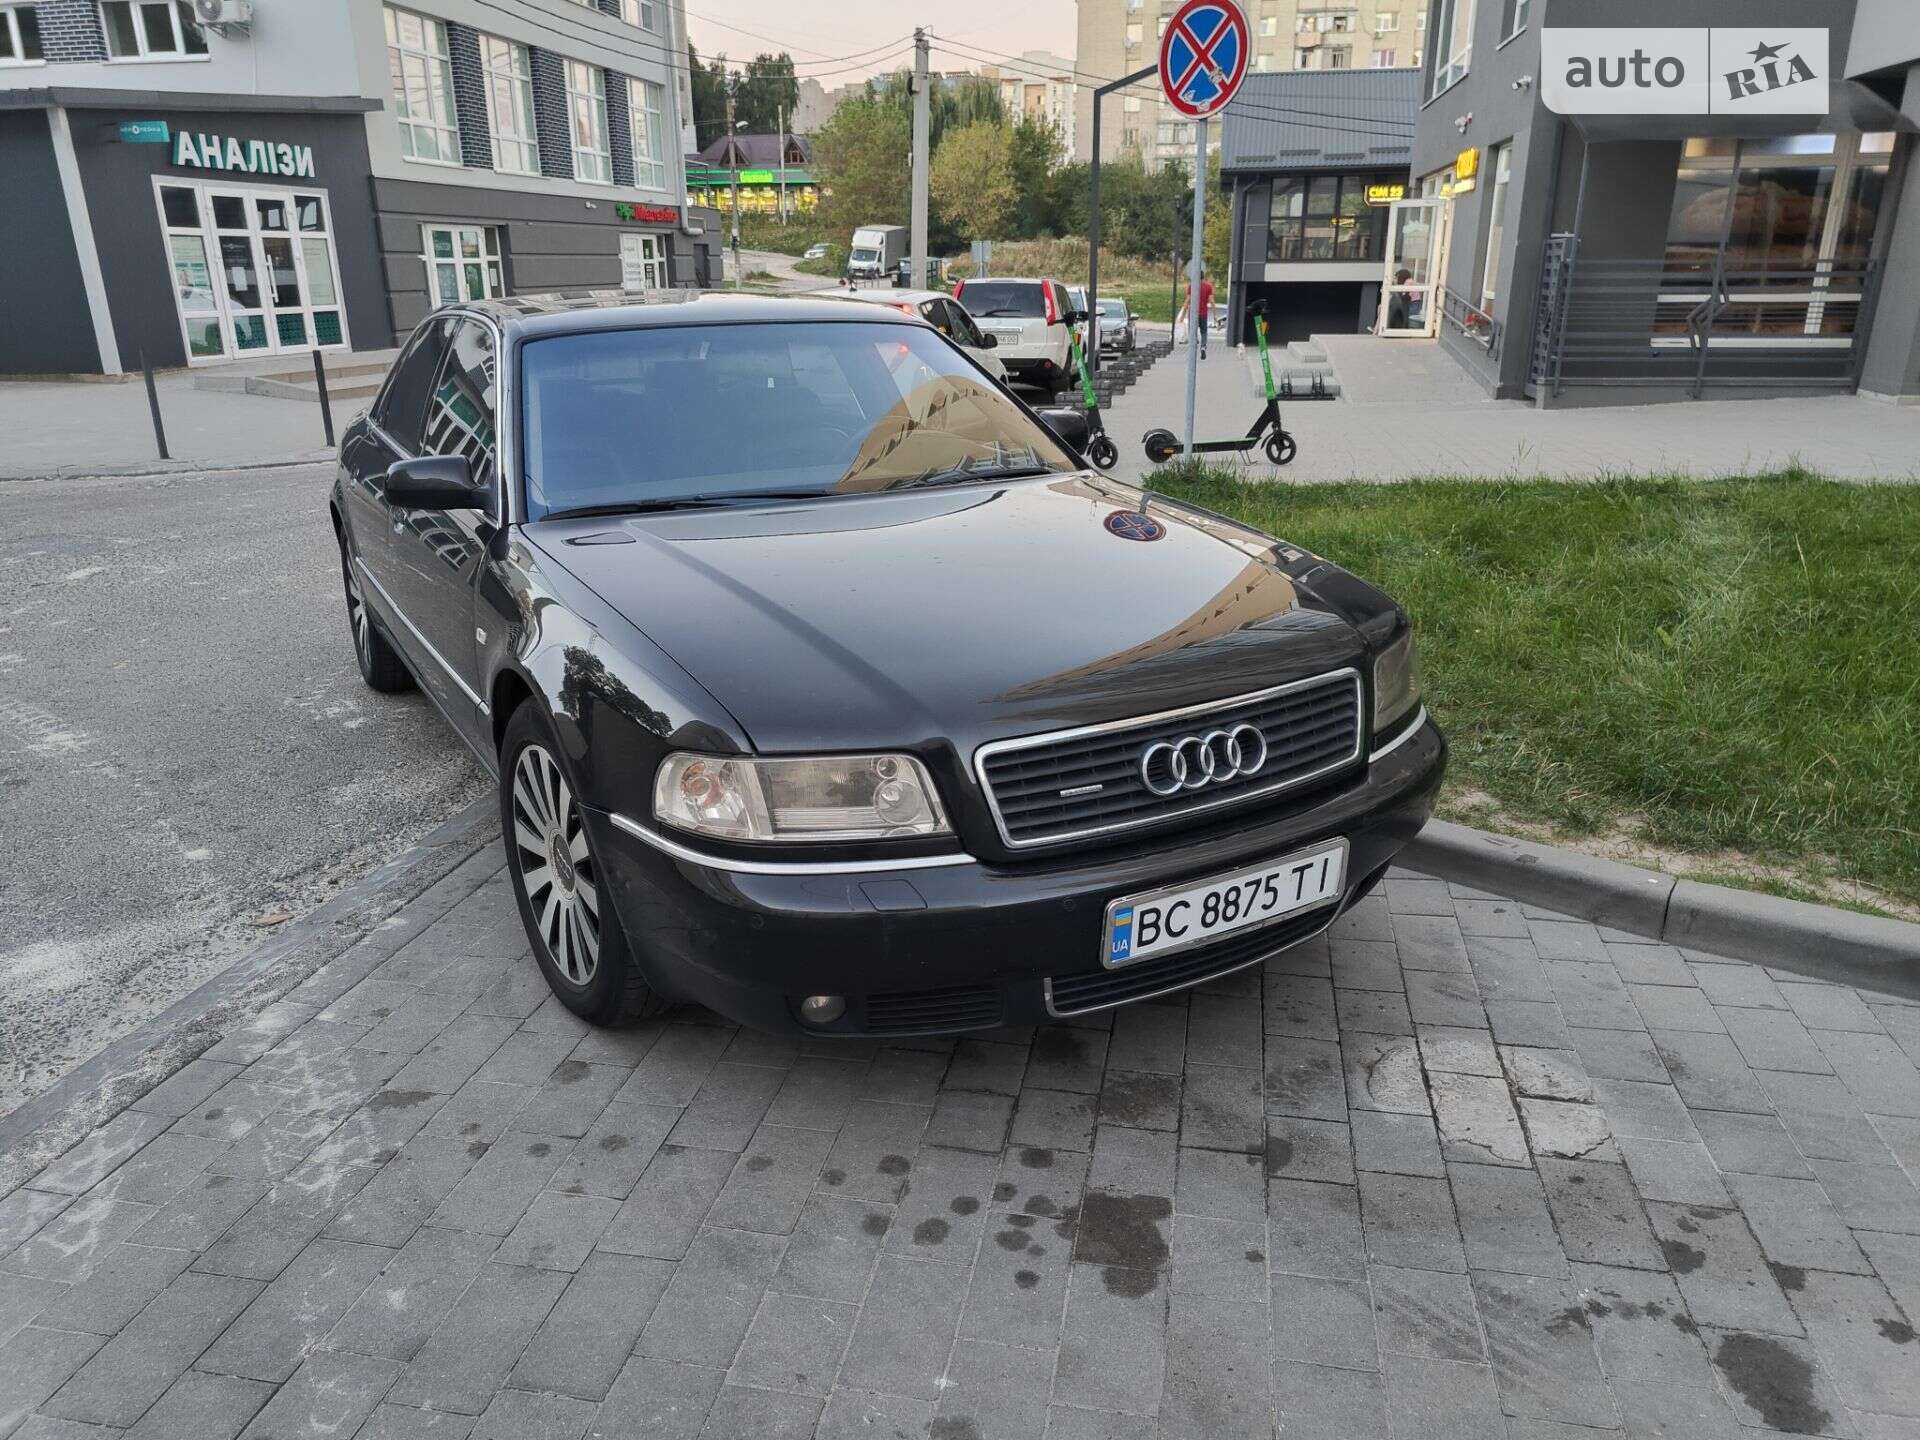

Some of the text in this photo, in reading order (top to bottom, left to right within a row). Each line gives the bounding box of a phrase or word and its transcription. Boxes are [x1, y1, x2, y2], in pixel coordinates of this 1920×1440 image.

[175, 130, 316, 178] АНАЛІЗИ
[1137, 900, 1191, 948] BC
[1200, 872, 1280, 929] 8875
[1112, 939, 1129, 953] UA
